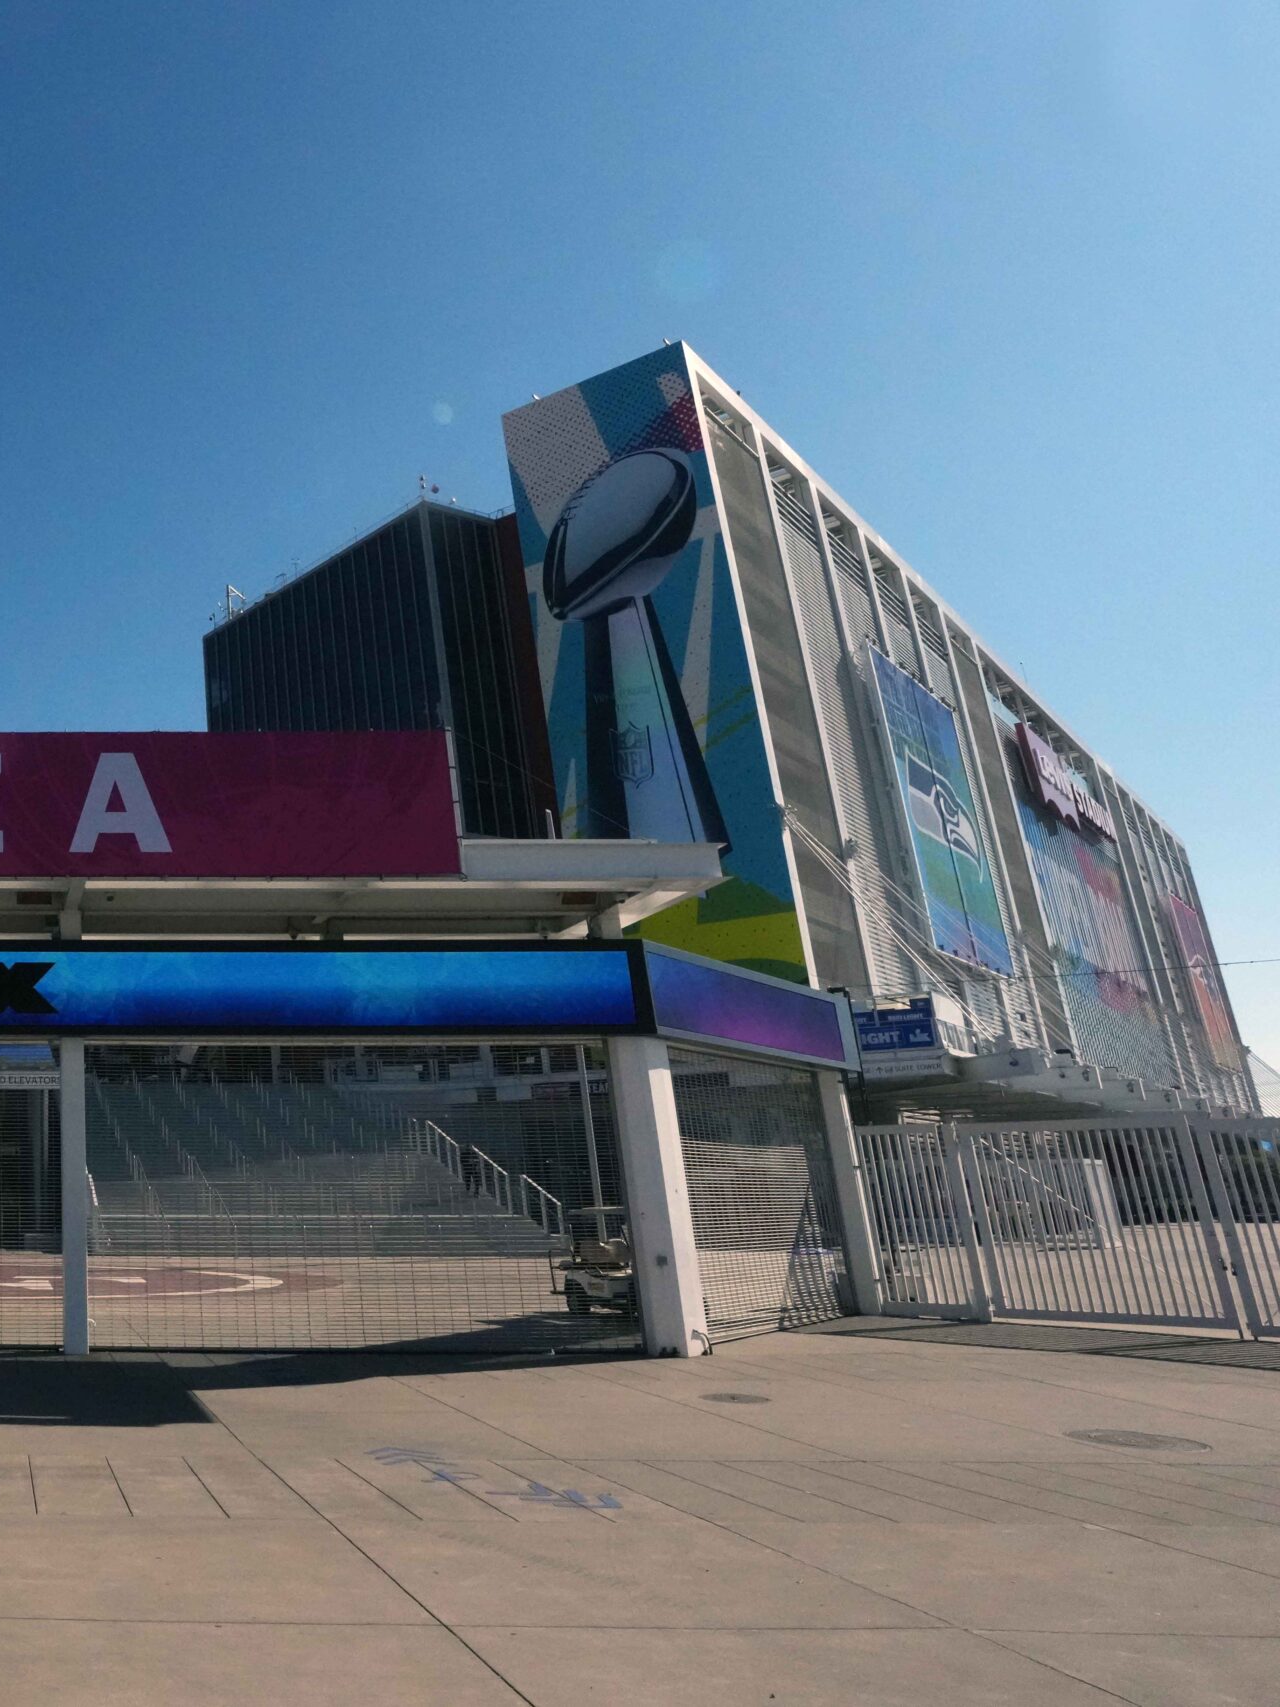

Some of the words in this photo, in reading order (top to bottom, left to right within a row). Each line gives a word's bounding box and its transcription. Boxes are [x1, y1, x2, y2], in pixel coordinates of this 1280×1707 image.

[619, 751, 651, 777] NFL
[68, 751, 173, 853] A
[861, 1031, 900, 1045] IGHT
